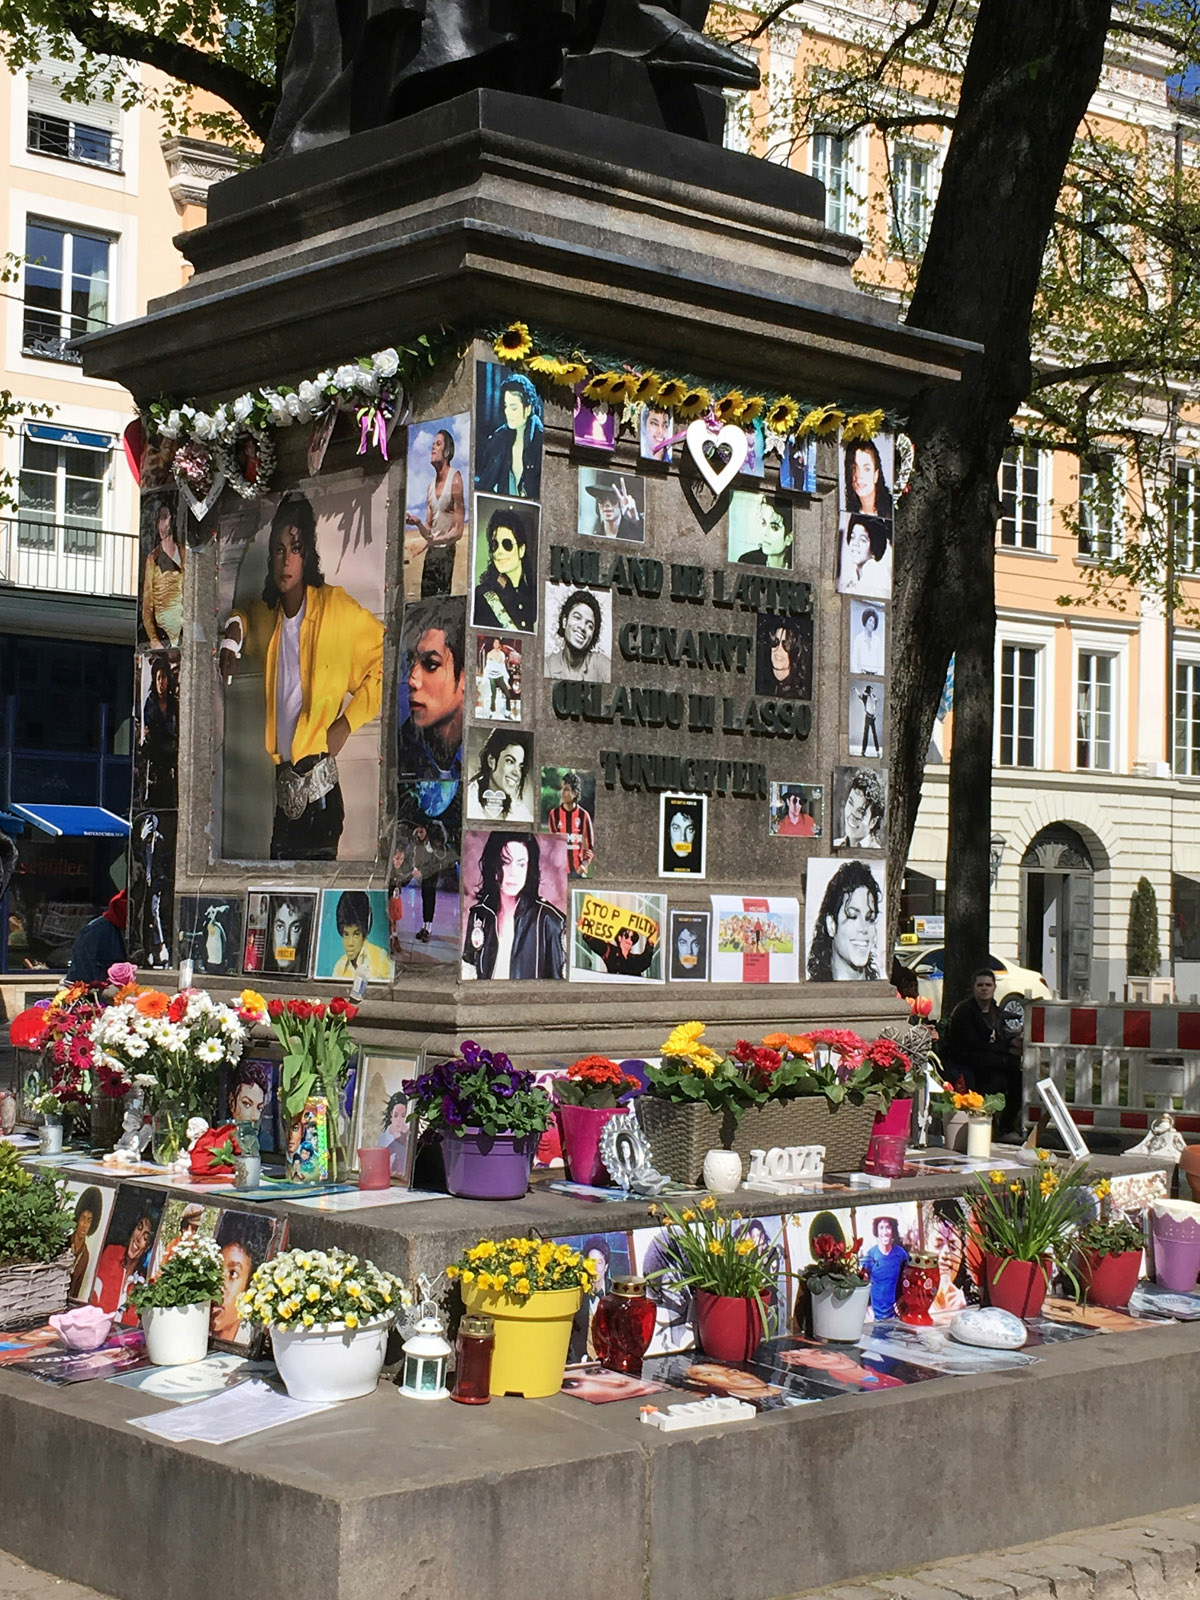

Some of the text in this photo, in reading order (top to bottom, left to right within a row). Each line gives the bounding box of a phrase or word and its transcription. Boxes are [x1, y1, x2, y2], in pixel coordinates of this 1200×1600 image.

[550, 545, 664, 599] ROLAND
[712, 571, 814, 617] LATTRE
[619, 622, 753, 673] GENANNT
[552, 680, 684, 730] ORLANDO
[722, 699, 812, 741] LASSO
[600, 750, 767, 800] TONDICHTER
[581, 917, 614, 939] PRESS
[583, 899, 620, 920] STOP
[748, 1145, 826, 1182] LOVE
